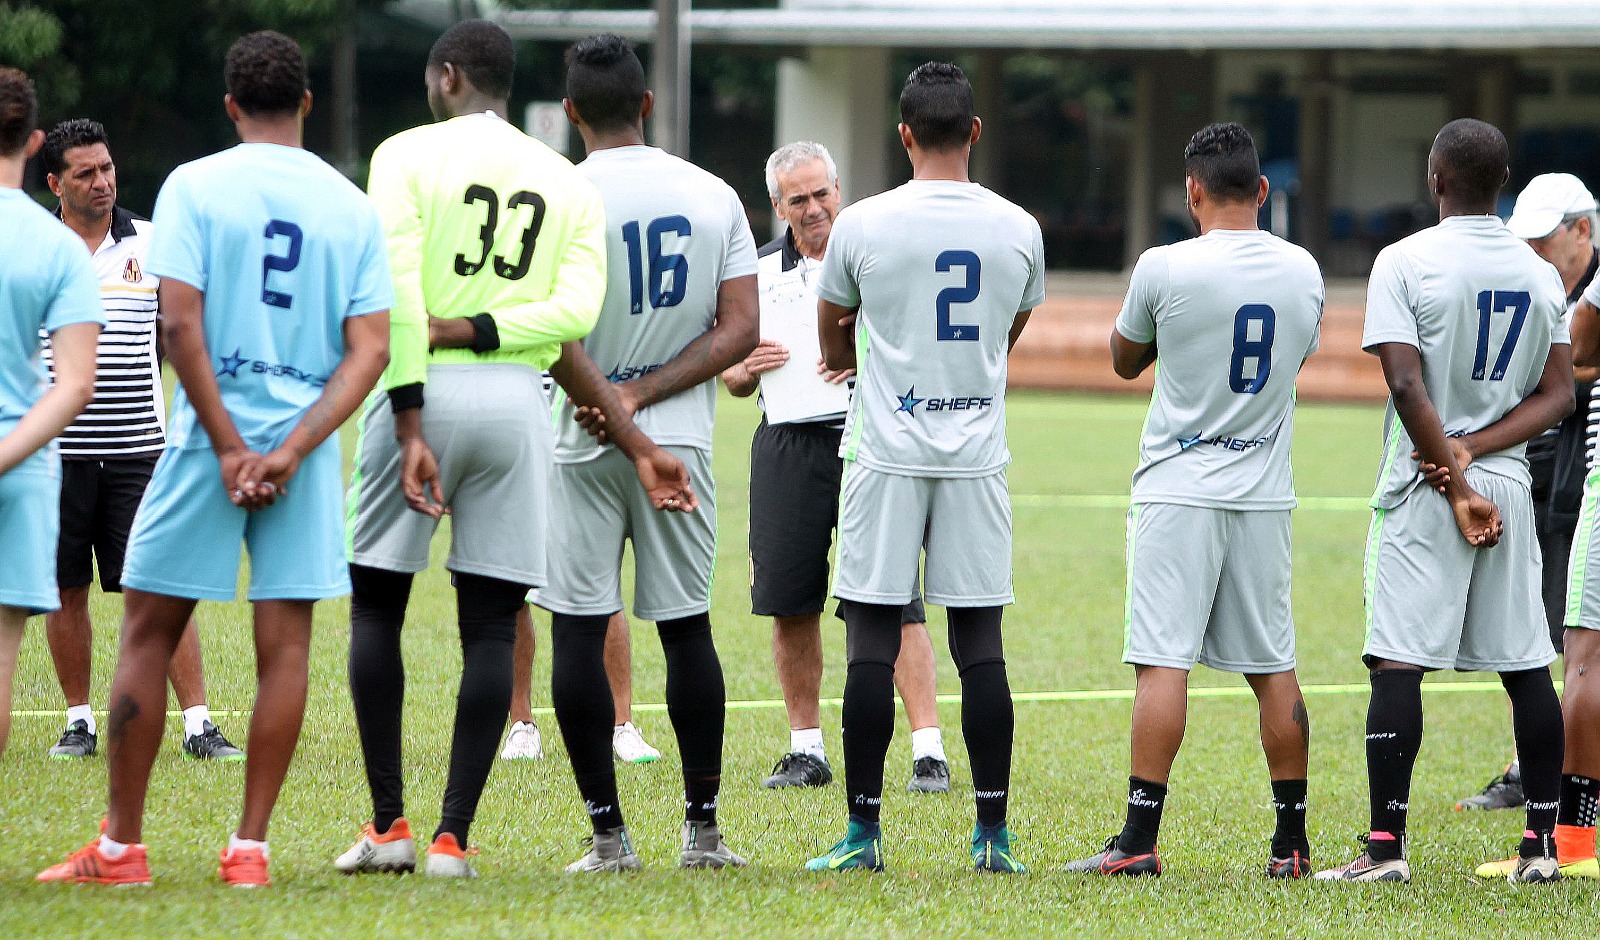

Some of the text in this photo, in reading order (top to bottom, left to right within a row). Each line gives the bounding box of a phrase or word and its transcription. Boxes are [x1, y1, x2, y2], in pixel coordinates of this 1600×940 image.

[261, 218, 304, 310] 2
[455, 183, 546, 280] 33
[621, 214, 692, 315] 16
[934, 250, 982, 342] 2
[1471, 290, 1532, 381] 17
[1229, 304, 1276, 394] 8
